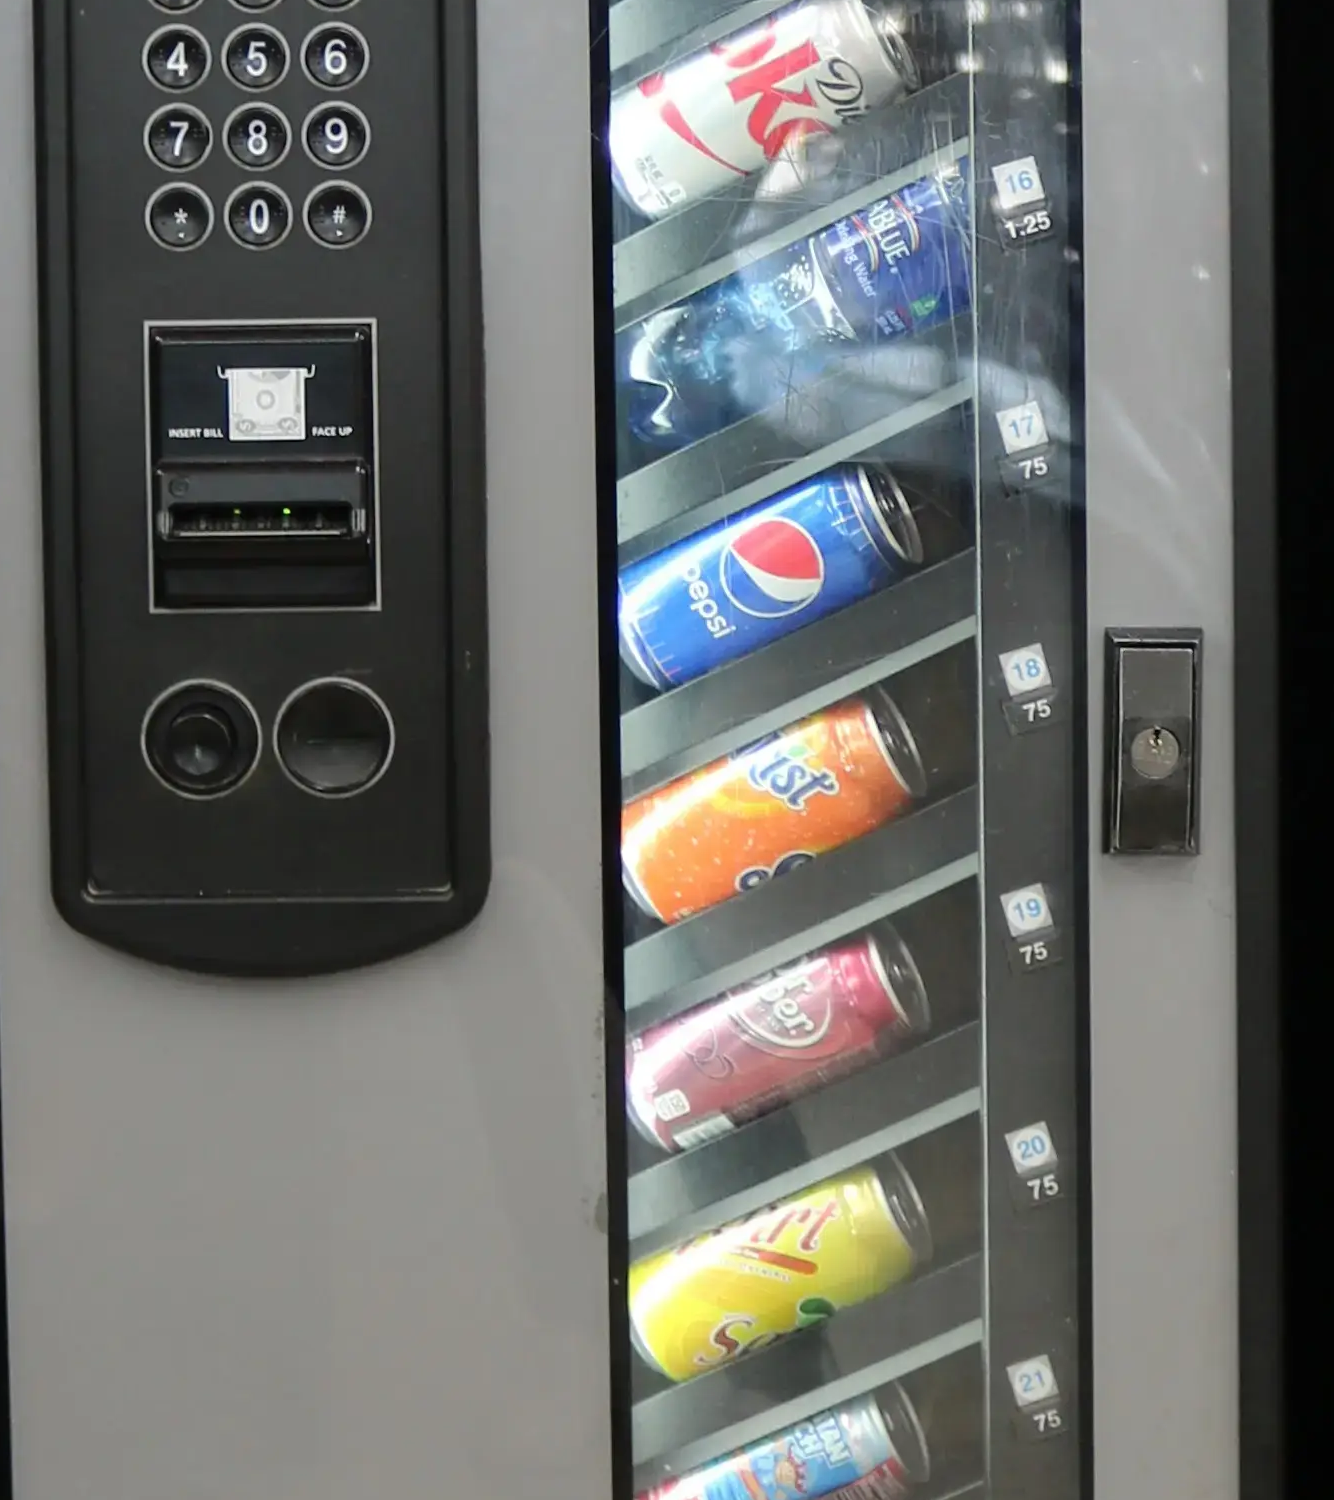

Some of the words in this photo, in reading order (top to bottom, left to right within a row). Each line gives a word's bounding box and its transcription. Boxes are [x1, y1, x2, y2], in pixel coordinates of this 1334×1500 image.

[166, 41, 188, 77] 4
[246, 40, 267, 77] 5
[323, 38, 347, 75] 6
[169, 121, 190, 157] 7
[247, 119, 268, 156] 8
[324, 117, 348, 155] 9
[1003, 169, 1035, 193] 16
[249, 198, 269, 235] 0
[1004, 210, 1052, 239] 1.25
[867, 199, 911, 262] ABLUE
[168, 428, 202, 439] INSERT
[203, 428, 224, 438] BILL
[312, 426, 337, 436] FACE
[339, 426, 354, 436] UP
[1007, 415, 1036, 439] 17
[1019, 456, 1048, 480] 75
[681, 563, 736, 640] pepsi
[1011, 658, 1041, 682] 18
[1022, 699, 1052, 722] 75
[1012, 897, 1042, 921] 19
[1020, 941, 1049, 964] 75
[1016, 1135, 1047, 1159] 20
[1026, 1174, 1059, 1201] 75
[1017, 1369, 1048, 1393] 21
[1033, 1409, 1061, 1432] 75
